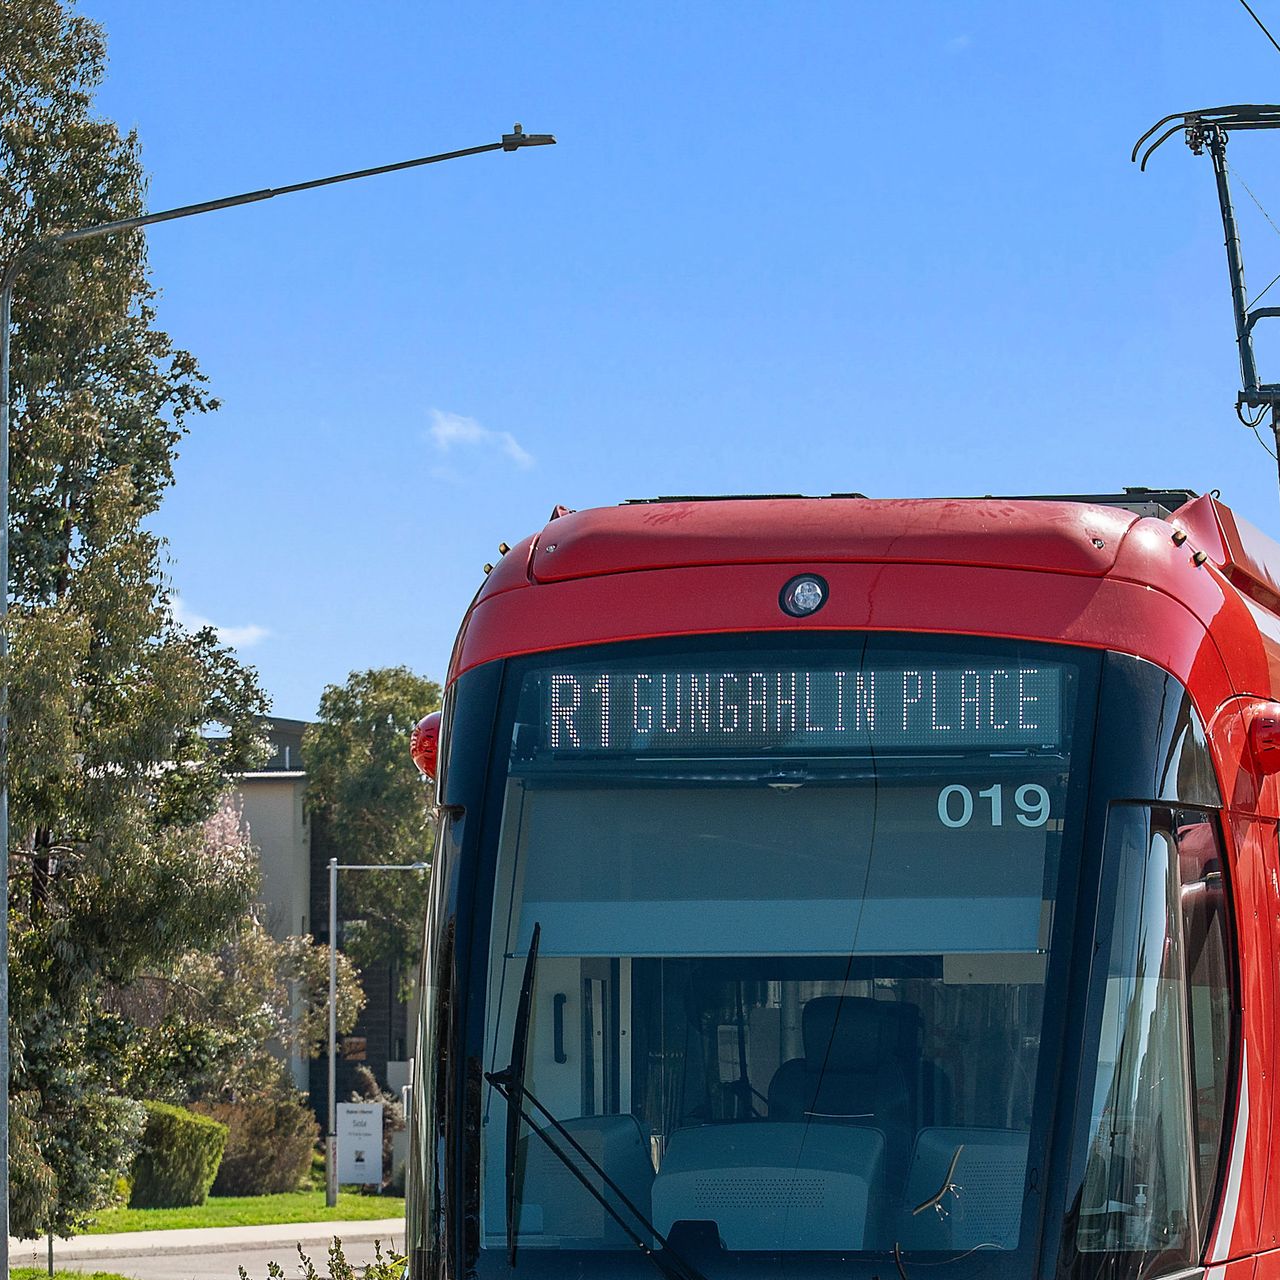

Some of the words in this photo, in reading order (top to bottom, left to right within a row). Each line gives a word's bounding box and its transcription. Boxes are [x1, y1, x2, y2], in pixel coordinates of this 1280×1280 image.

[550, 673, 610, 748] R1
[632, 671, 876, 734] GUNGAHLIN
[902, 669, 1040, 731] PLACE
[937, 783, 1052, 828] 019
